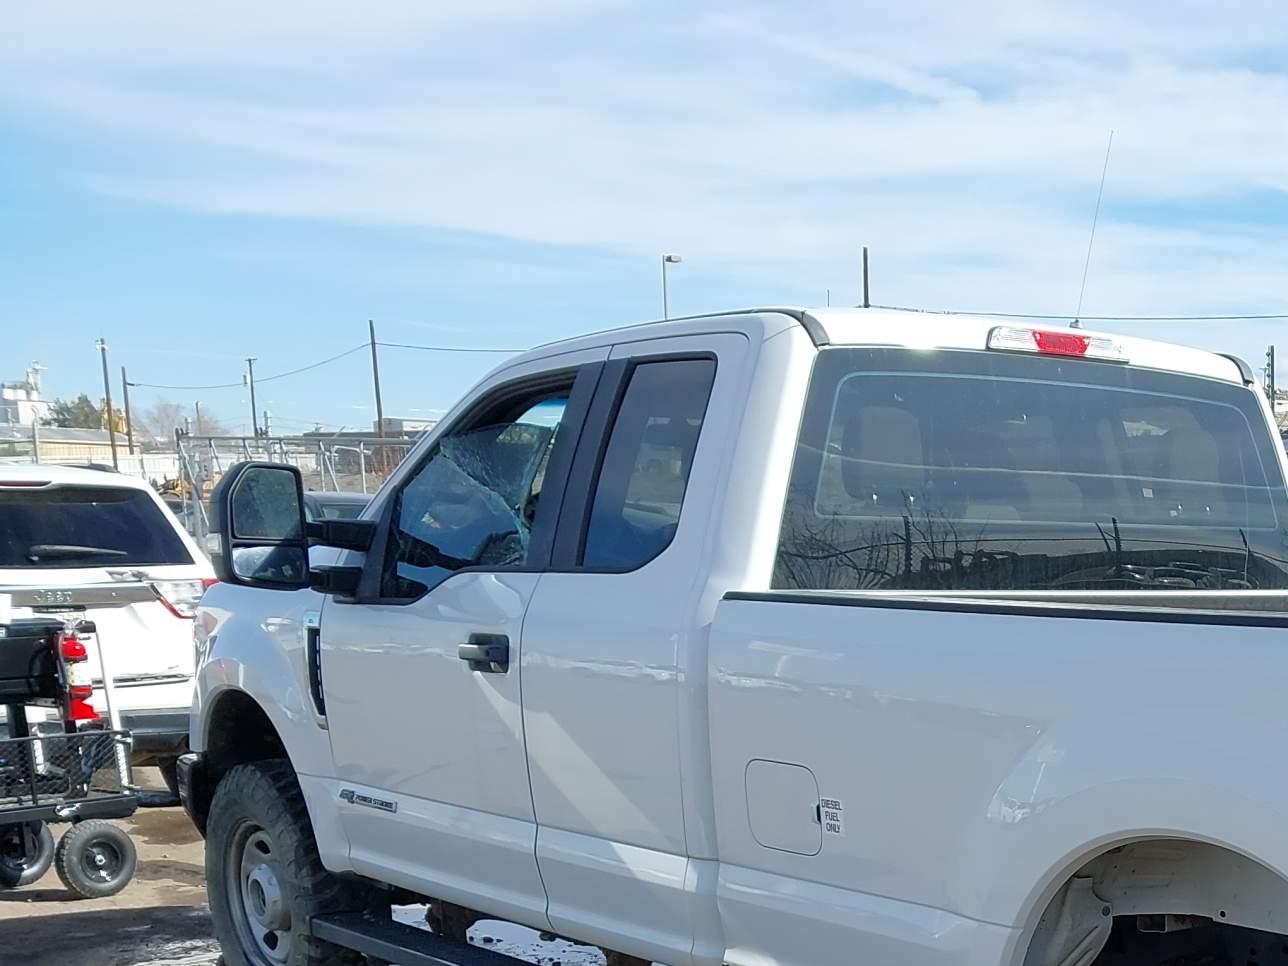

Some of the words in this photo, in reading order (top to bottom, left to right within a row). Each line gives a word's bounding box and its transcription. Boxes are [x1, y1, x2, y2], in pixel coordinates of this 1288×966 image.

[821, 799, 842, 811] DIESEL
[825, 811, 841, 822] FUEL
[825, 822, 841, 833] ONLY
